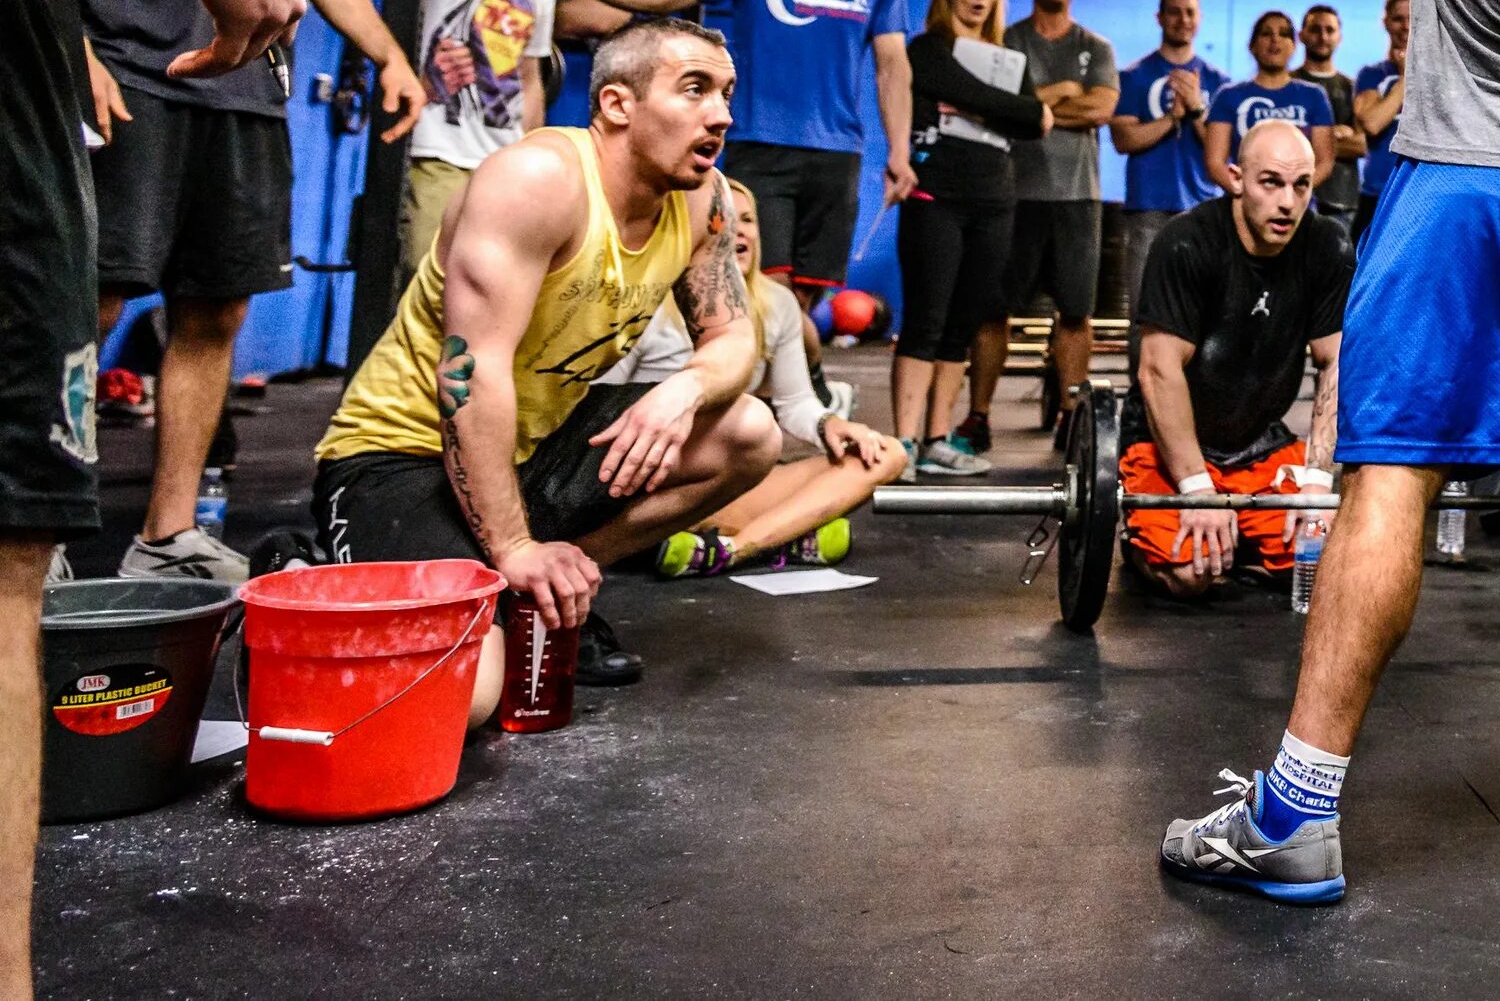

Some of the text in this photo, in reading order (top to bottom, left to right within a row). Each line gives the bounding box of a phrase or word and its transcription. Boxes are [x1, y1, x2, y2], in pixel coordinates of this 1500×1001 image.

[69, 693, 94, 704] LITER
[95, 687, 133, 702] PLASTIC
[134, 678, 167, 695] BUCKET
[1281, 761, 1335, 790] HOSPITAL
